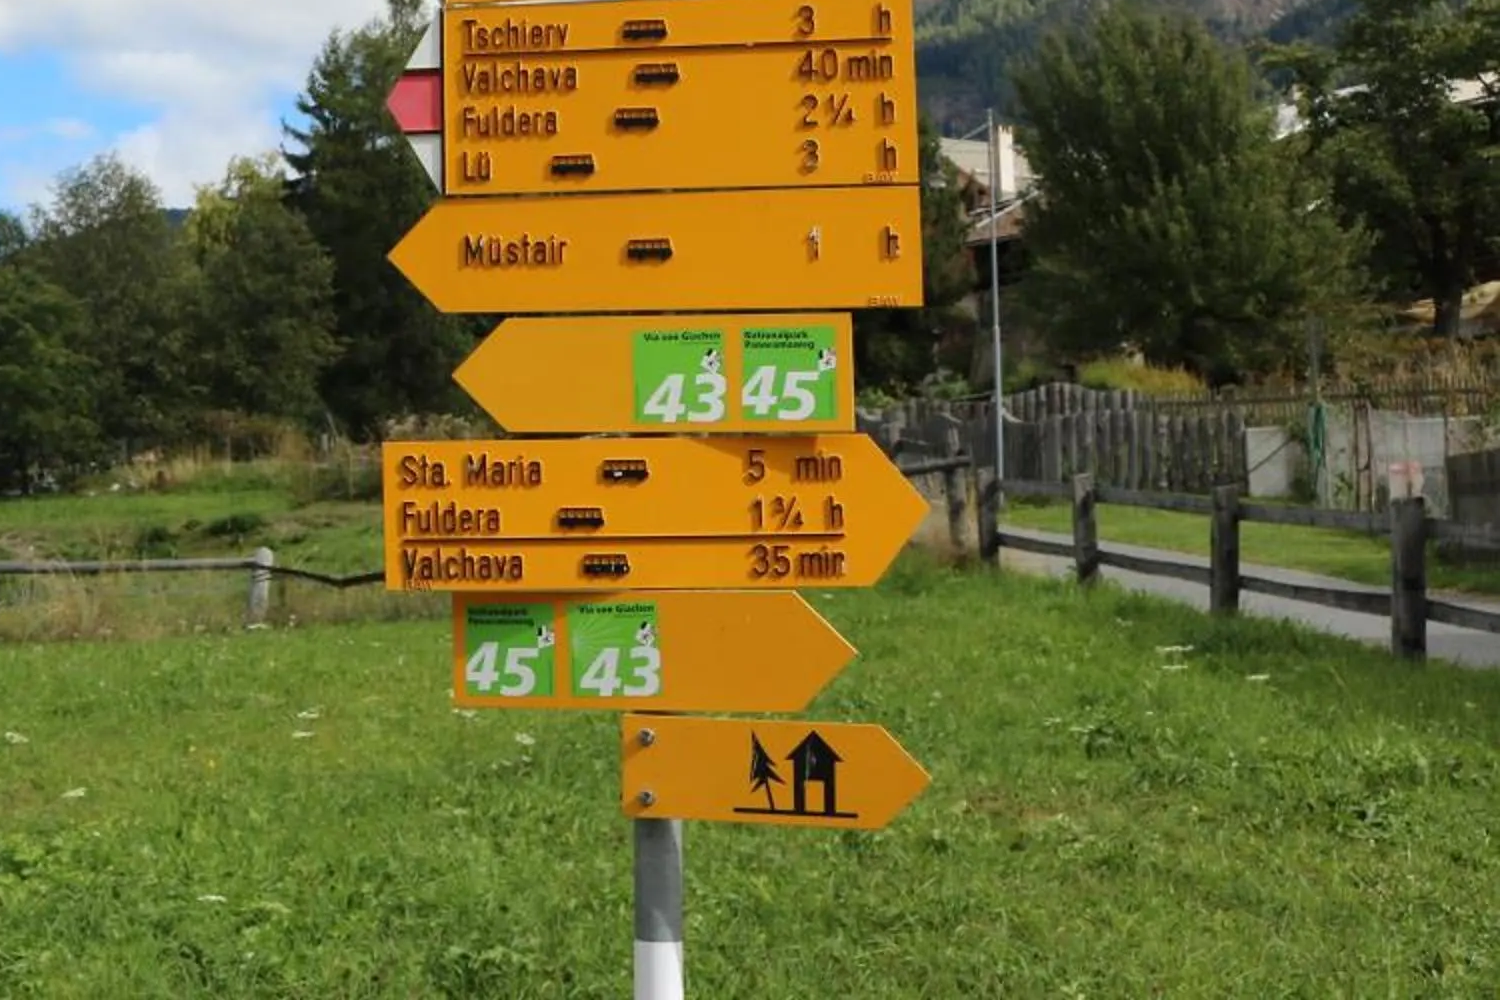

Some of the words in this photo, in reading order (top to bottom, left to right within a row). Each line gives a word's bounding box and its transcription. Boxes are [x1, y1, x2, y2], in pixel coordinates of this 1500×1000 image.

[462, 17, 569, 50] Tschierv
[798, 4, 815, 36] 3
[876, 2, 891, 33] h
[462, 60, 579, 94] Valchava
[798, 47, 838, 81] 40
[847, 49, 893, 81] min
[462, 104, 559, 139] Fuldera
[879, 91, 895, 125] h
[462, 150, 492, 183] Lü
[802, 138, 819, 173] 3
[881, 137, 897, 172] h
[463, 232, 568, 267] Müstair
[882, 225, 900, 262] h
[643, 373, 727, 423] 43
[741, 365, 820, 420] 45
[400, 453, 451, 489] Sta.
[466, 453, 542, 488] Maria
[746, 449, 765, 484] 5
[794, 450, 842, 482] min
[402, 501, 501, 534] Fuldera
[827, 494, 844, 529] h
[402, 547, 524, 581] Valchava
[751, 543, 791, 577] 35
[799, 544, 846, 578] min
[466, 641, 539, 696] 45
[580, 646, 661, 697] 43
